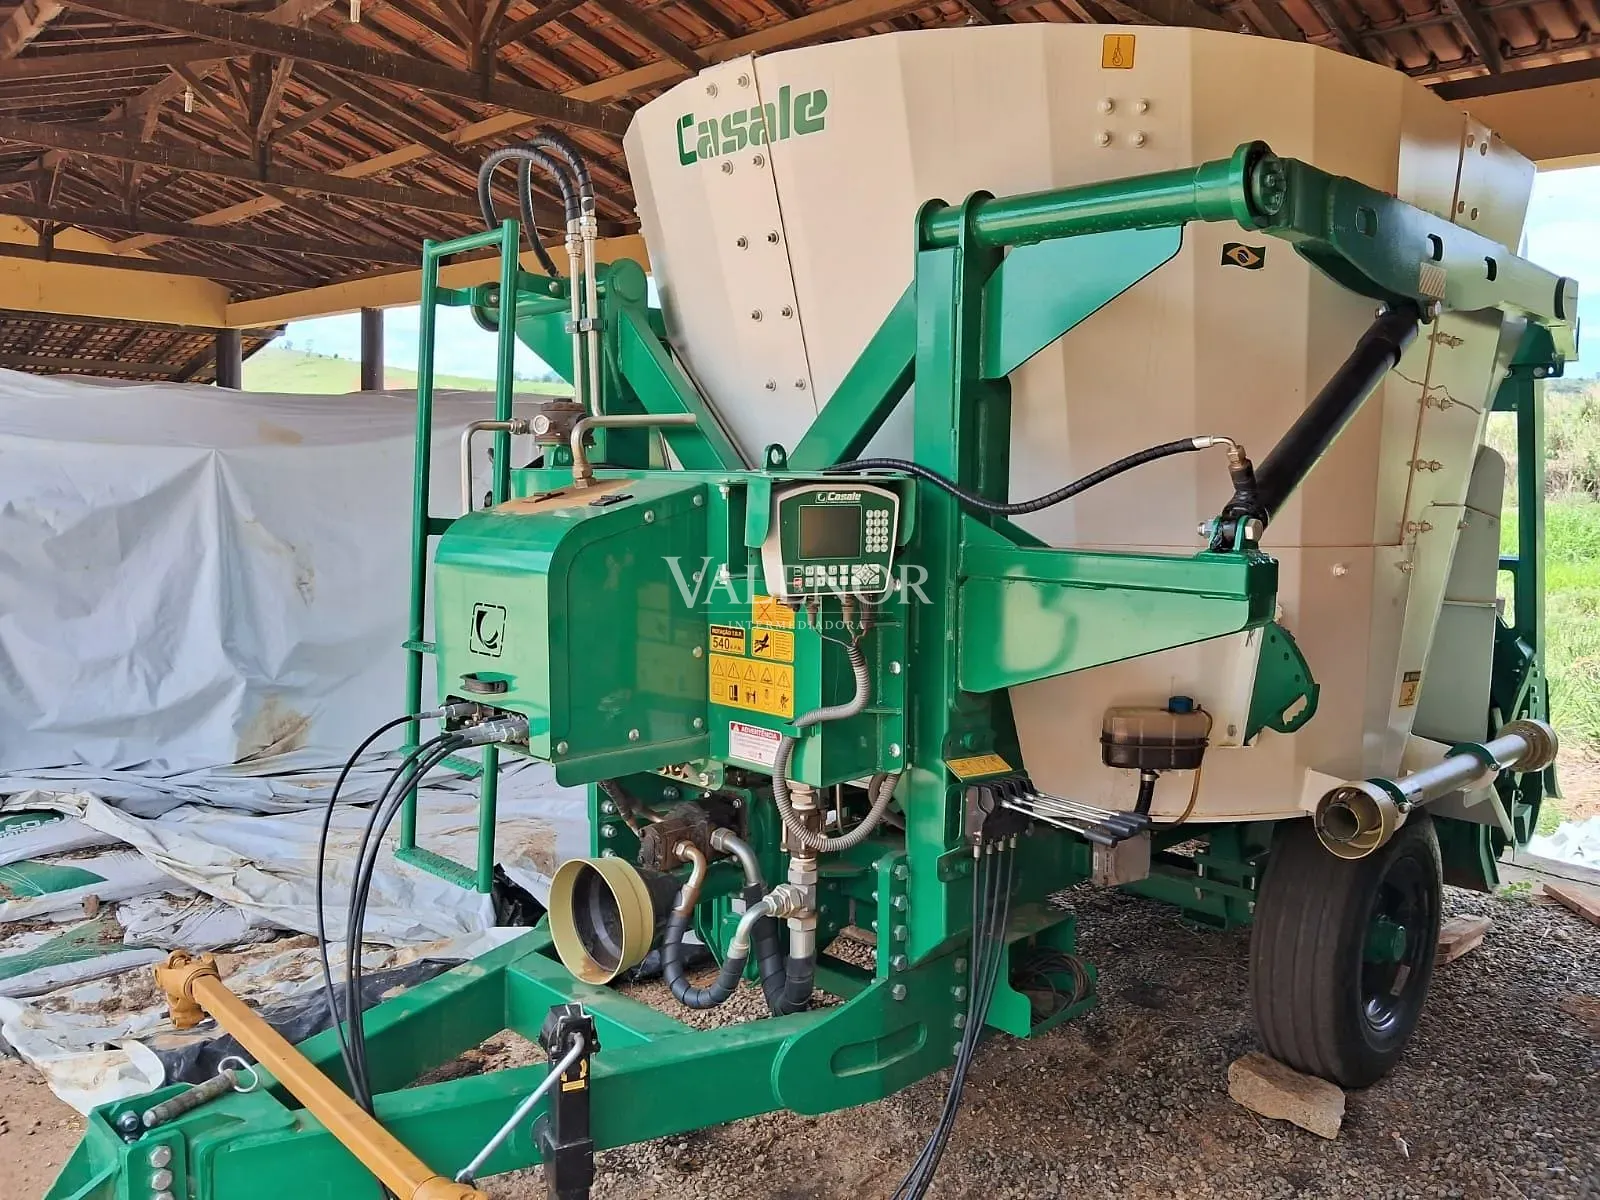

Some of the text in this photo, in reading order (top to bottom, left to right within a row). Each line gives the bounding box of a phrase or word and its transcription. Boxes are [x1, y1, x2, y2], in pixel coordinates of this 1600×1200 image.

[676, 85, 828, 166] Casale
[827, 492, 861, 501] Casale
[712, 637, 729, 649] 540
